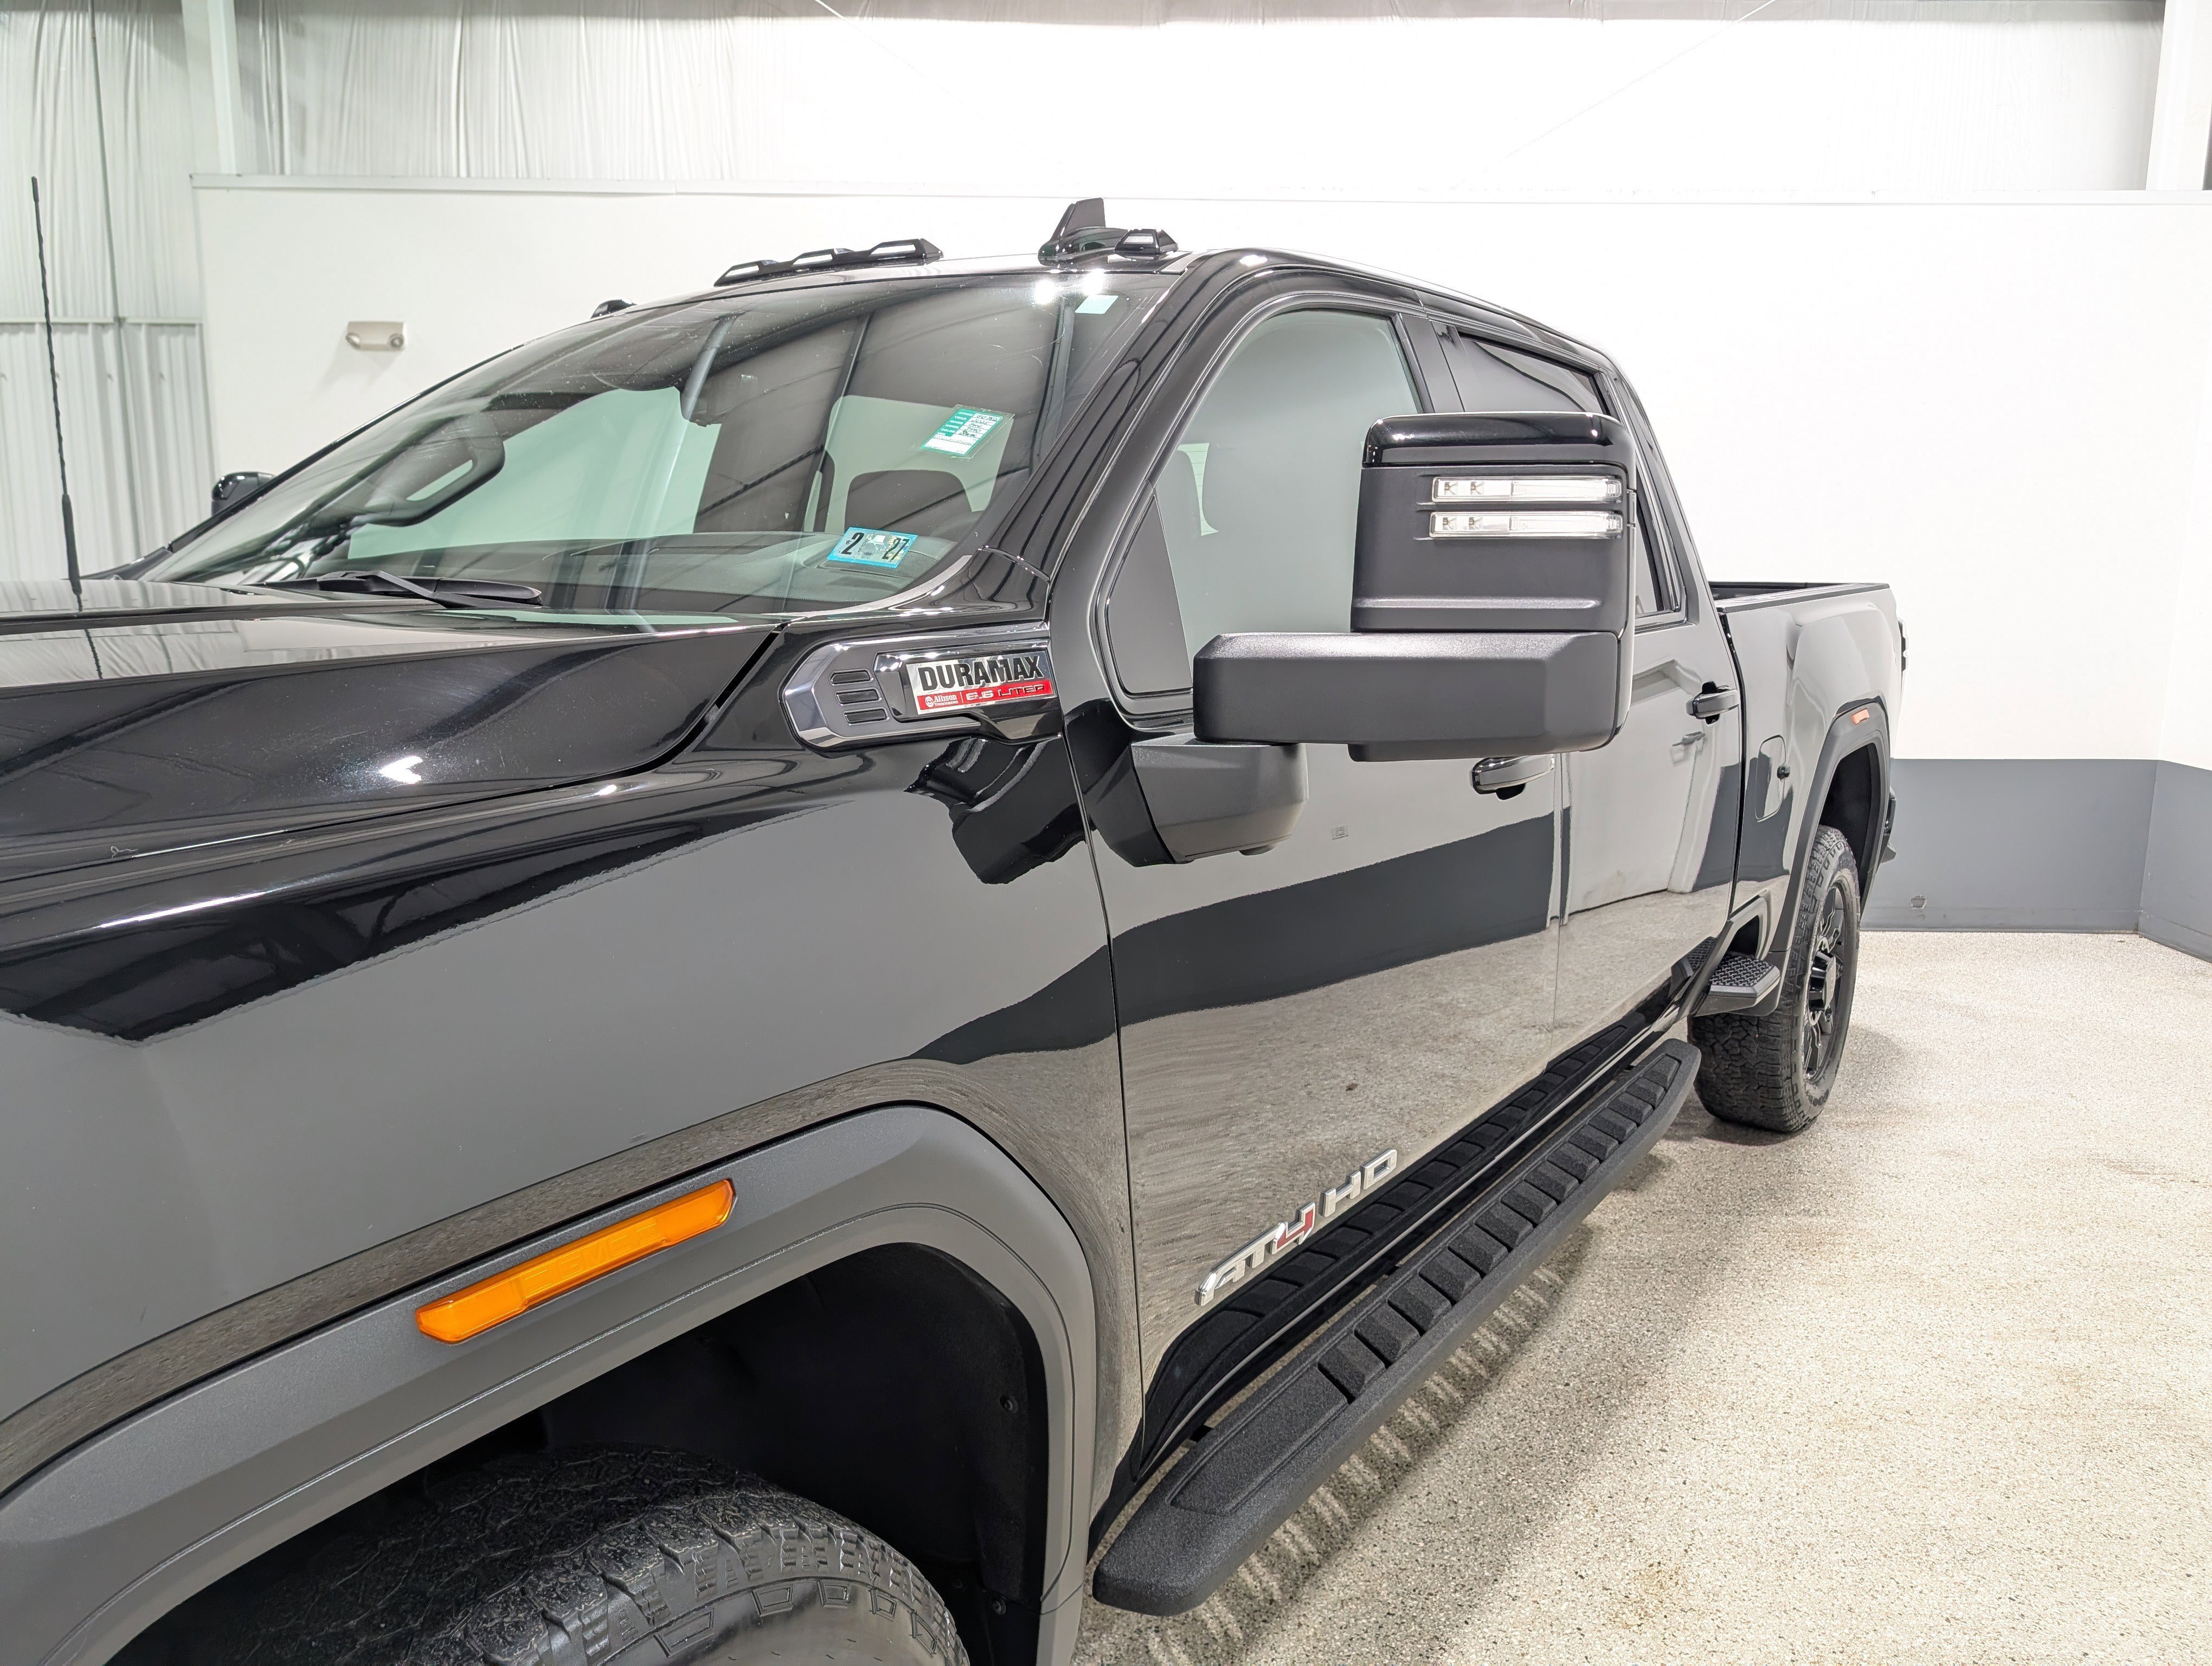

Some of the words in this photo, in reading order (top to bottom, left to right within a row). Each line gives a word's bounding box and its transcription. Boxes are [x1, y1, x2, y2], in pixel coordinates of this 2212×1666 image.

[840, 532, 865, 555] 2
[882, 537, 910, 560] 27
[917, 656, 1044, 691] DURAMAX
[934, 694, 958, 703] Allison
[965, 690, 994, 701] 6.6
[998, 684, 1045, 697] LITER
[1195, 1202, 1315, 1306] AT4
[1321, 1149, 1398, 1217] HD
